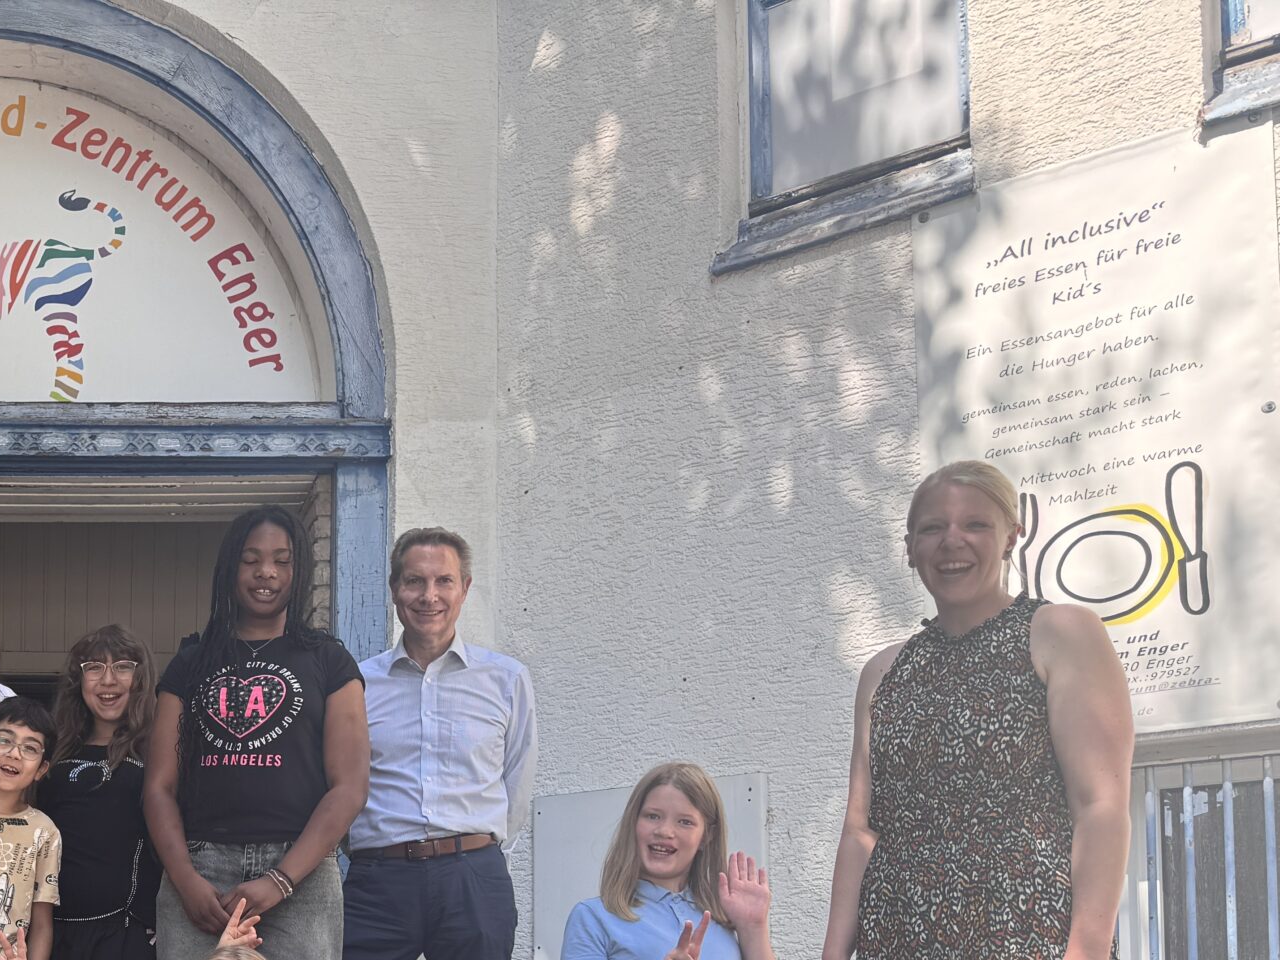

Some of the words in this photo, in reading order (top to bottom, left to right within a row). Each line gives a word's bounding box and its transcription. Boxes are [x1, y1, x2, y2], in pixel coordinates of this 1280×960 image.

[975, 276, 1026, 298] freies
[1034, 261, 1088, 283] Essen
[1097, 249, 1128, 266] für
[1136, 232, 1182, 255] freie
[206, 242, 284, 374] Enger
[966, 344, 993, 360] Ein
[1000, 313, 1123, 352] Essensangebot
[1130, 306, 1158, 321] für
[1164, 293, 1195, 311] alle
[999, 363, 1024, 378] die
[1032, 349, 1096, 372] Hunger
[1102, 334, 1159, 355] haben.
[961, 398, 1041, 424] gemeinsam
[1047, 388, 1089, 403] essen,
[1095, 375, 1143, 392] reden,
[1149, 361, 1204, 379] lachen,
[992, 414, 1073, 439] gemeinsam
[1079, 401, 1117, 419] stark
[1123, 393, 1151, 408] sein
[984, 432, 1082, 460] Gemeinschaft
[1088, 419, 1136, 439] macht
[1141, 409, 1182, 427] stark
[1020, 464, 1097, 488] Mittwoch
[1103, 456, 1135, 472] eine
[1142, 443, 1204, 463] warme
[1048, 483, 1119, 508] Mahlzeit
[1126, 630, 1161, 644] und
[1137, 642, 1189, 657] Enger
[246, 661, 267, 669] CITY
[268, 663, 280, 671] OF
[1146, 655, 1194, 670] Enger
[279, 668, 302, 693] DREAMS
[289, 696, 304, 716] CITY
[282, 716, 293, 728] OF
[248, 726, 282, 750] DREAMS
[201, 755, 218, 767] LOS
[222, 754, 282, 767] ANGELES
